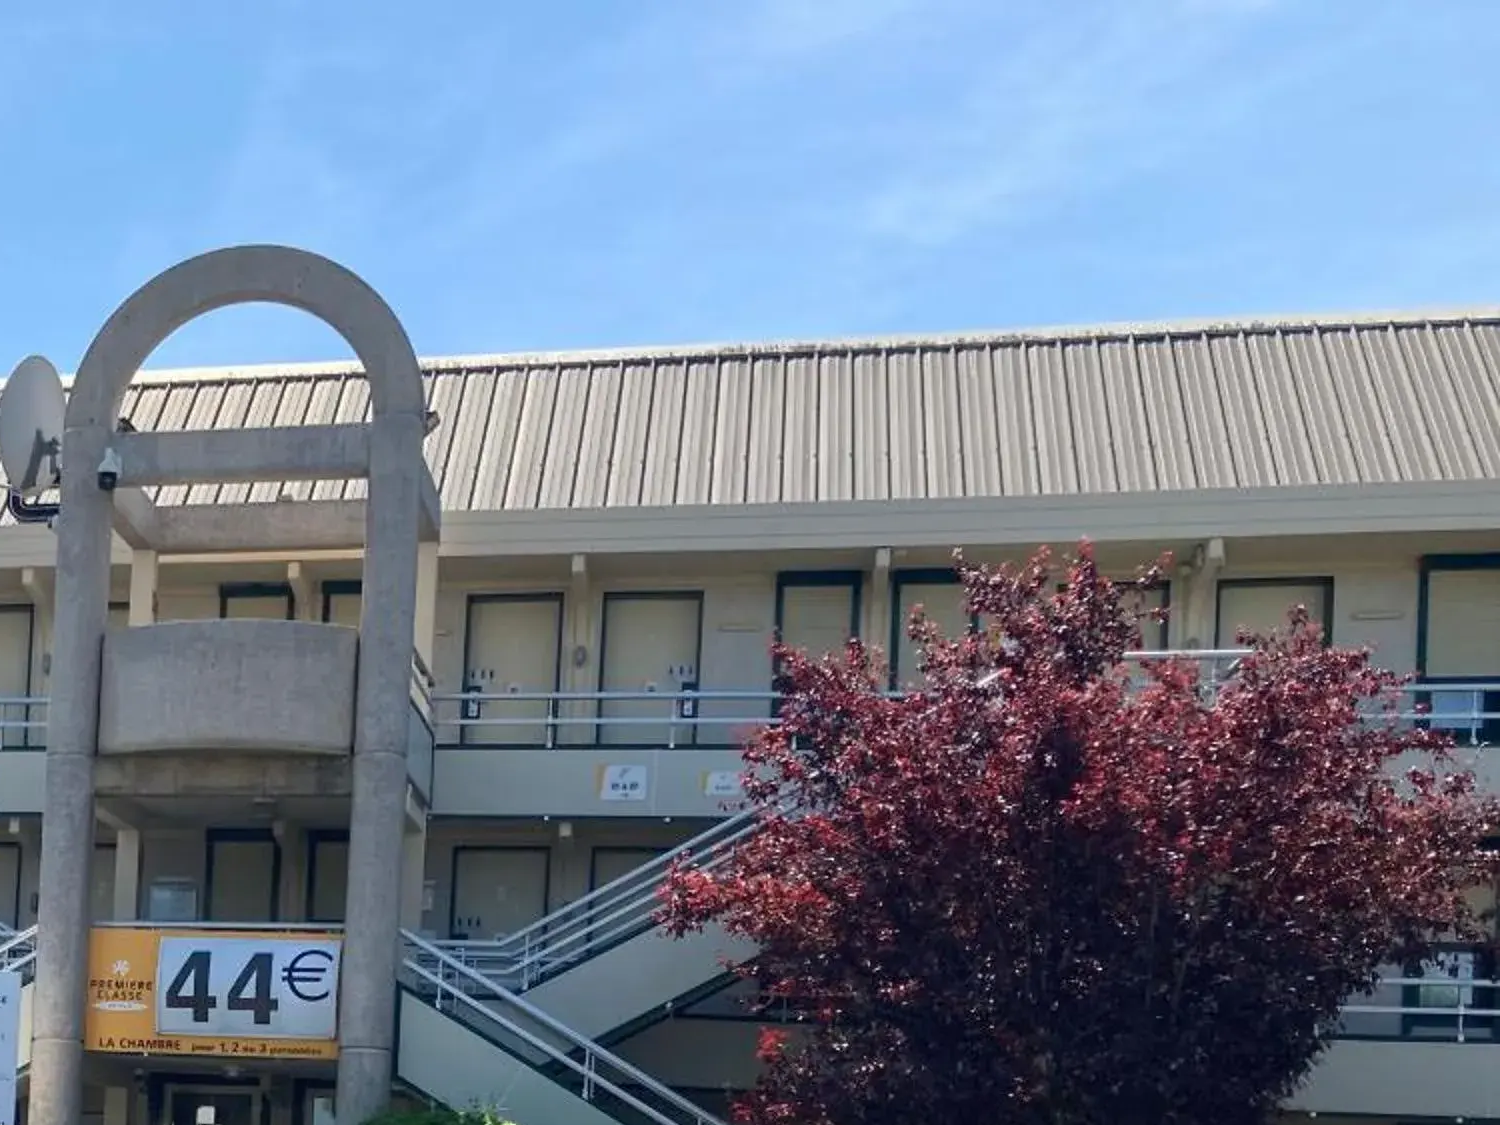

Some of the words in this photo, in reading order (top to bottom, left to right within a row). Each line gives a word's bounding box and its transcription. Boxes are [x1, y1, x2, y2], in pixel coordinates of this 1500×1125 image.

[165, 949, 334, 1025] 44€
[96, 990, 143, 1001] CLASSE
[99, 1037, 115, 1049] LA
[119, 1038, 181, 1051] CHAMBRE
